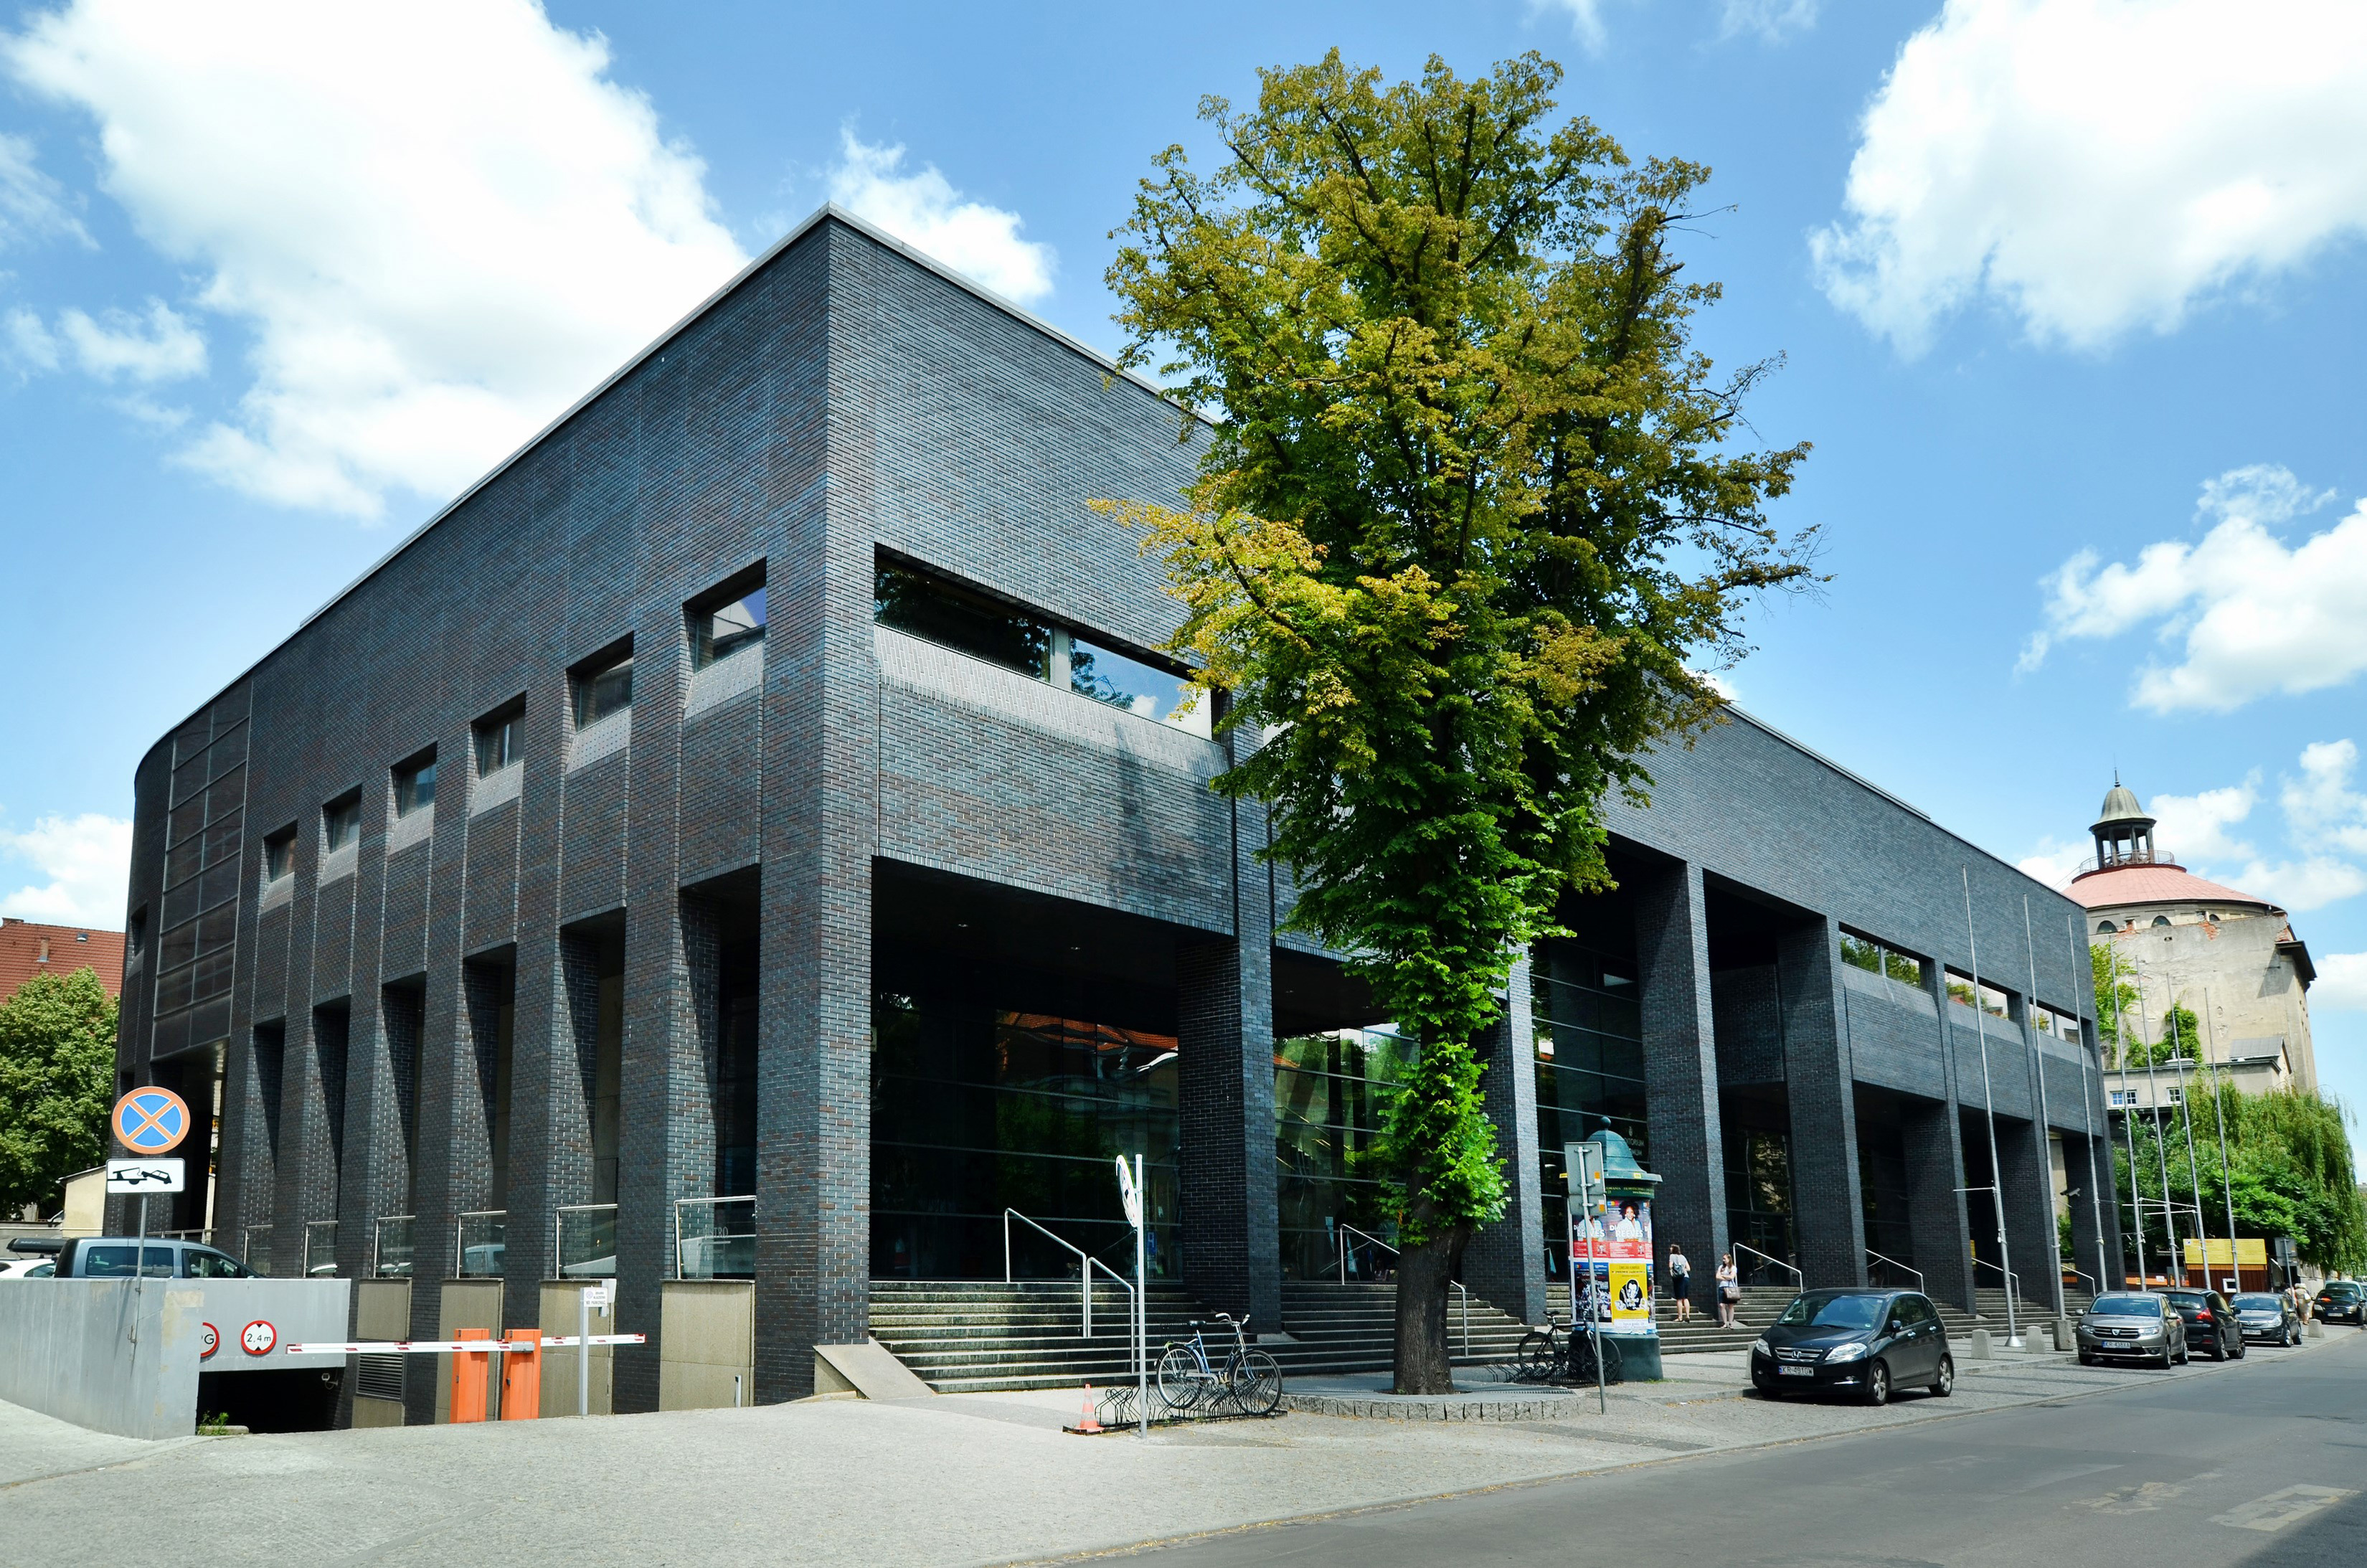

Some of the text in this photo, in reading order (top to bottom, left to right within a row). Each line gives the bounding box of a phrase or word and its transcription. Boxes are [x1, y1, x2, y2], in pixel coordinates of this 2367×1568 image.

[1616, 1229, 1643, 1238] REEVES
[202, 1333, 214, 1345] G
[247, 1333, 263, 1343] 2,4
